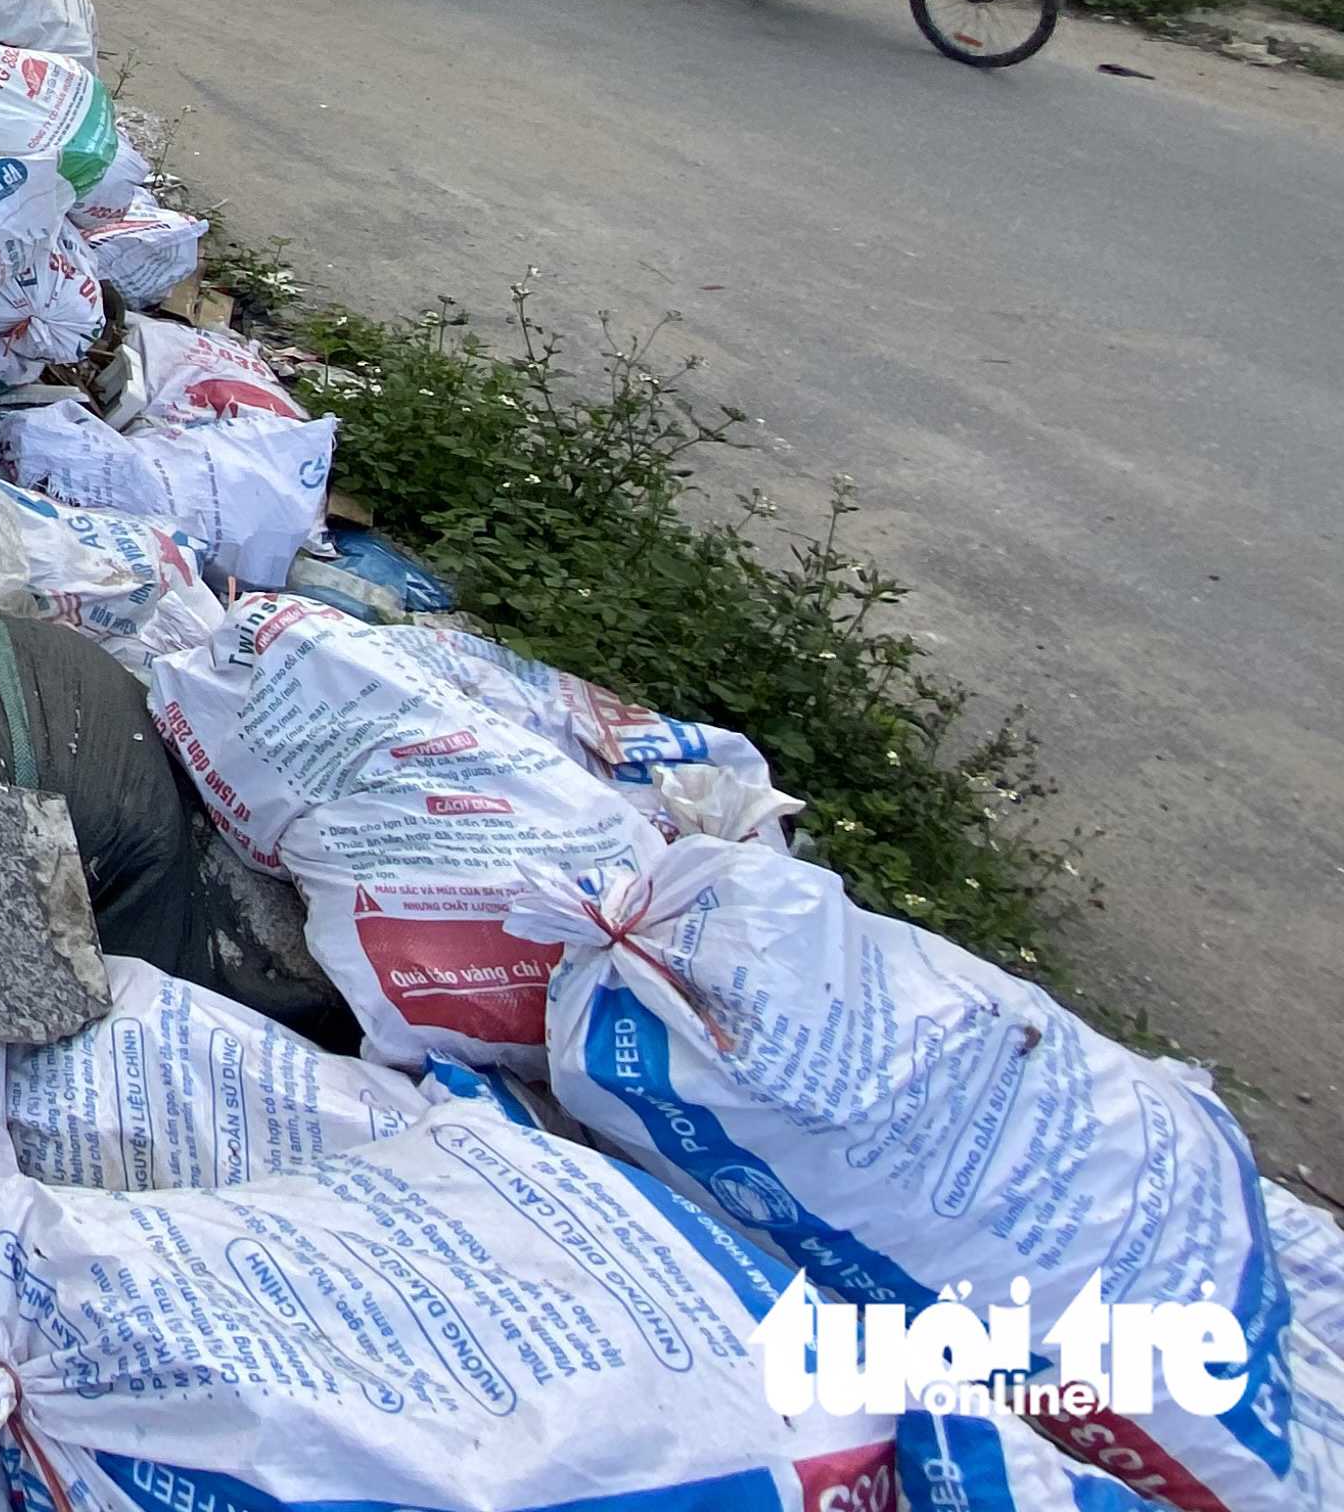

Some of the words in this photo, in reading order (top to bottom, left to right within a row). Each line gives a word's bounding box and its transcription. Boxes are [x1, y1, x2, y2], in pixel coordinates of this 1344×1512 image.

[67, 514, 105, 551] AG
[390, 967, 428, 988] Quả
[463, 964, 509, 982] vàng
[511, 958, 541, 978] chỉ
[123, 1028, 139, 1078] CHÍNH
[128, 1082, 145, 1121] LIỆU
[503, 1173, 556, 1224] CẦN
[548, 1215, 608, 1273] ĐIỀU
[242, 1247, 301, 1321] CHÍNH
[435, 1317, 507, 1404] HƯỚNG
